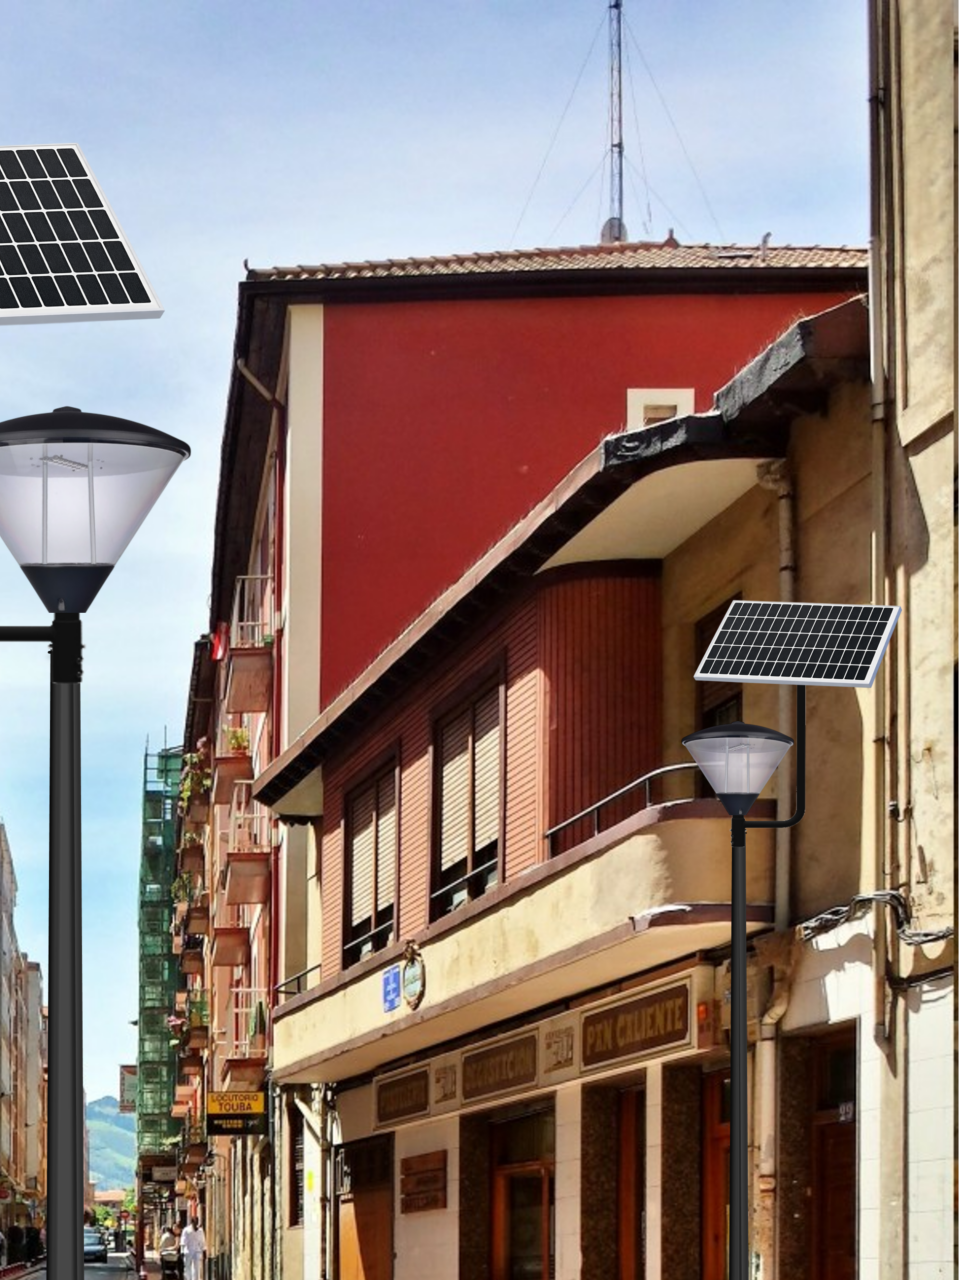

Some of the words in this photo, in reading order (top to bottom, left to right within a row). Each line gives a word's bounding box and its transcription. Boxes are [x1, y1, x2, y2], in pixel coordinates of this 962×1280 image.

[586, 1018, 613, 1056] PAN
[616, 996, 684, 1047] CALIENTE
[211, 1094, 259, 1102] LOCUTORIO
[218, 1102, 253, 1112] TOUBA
